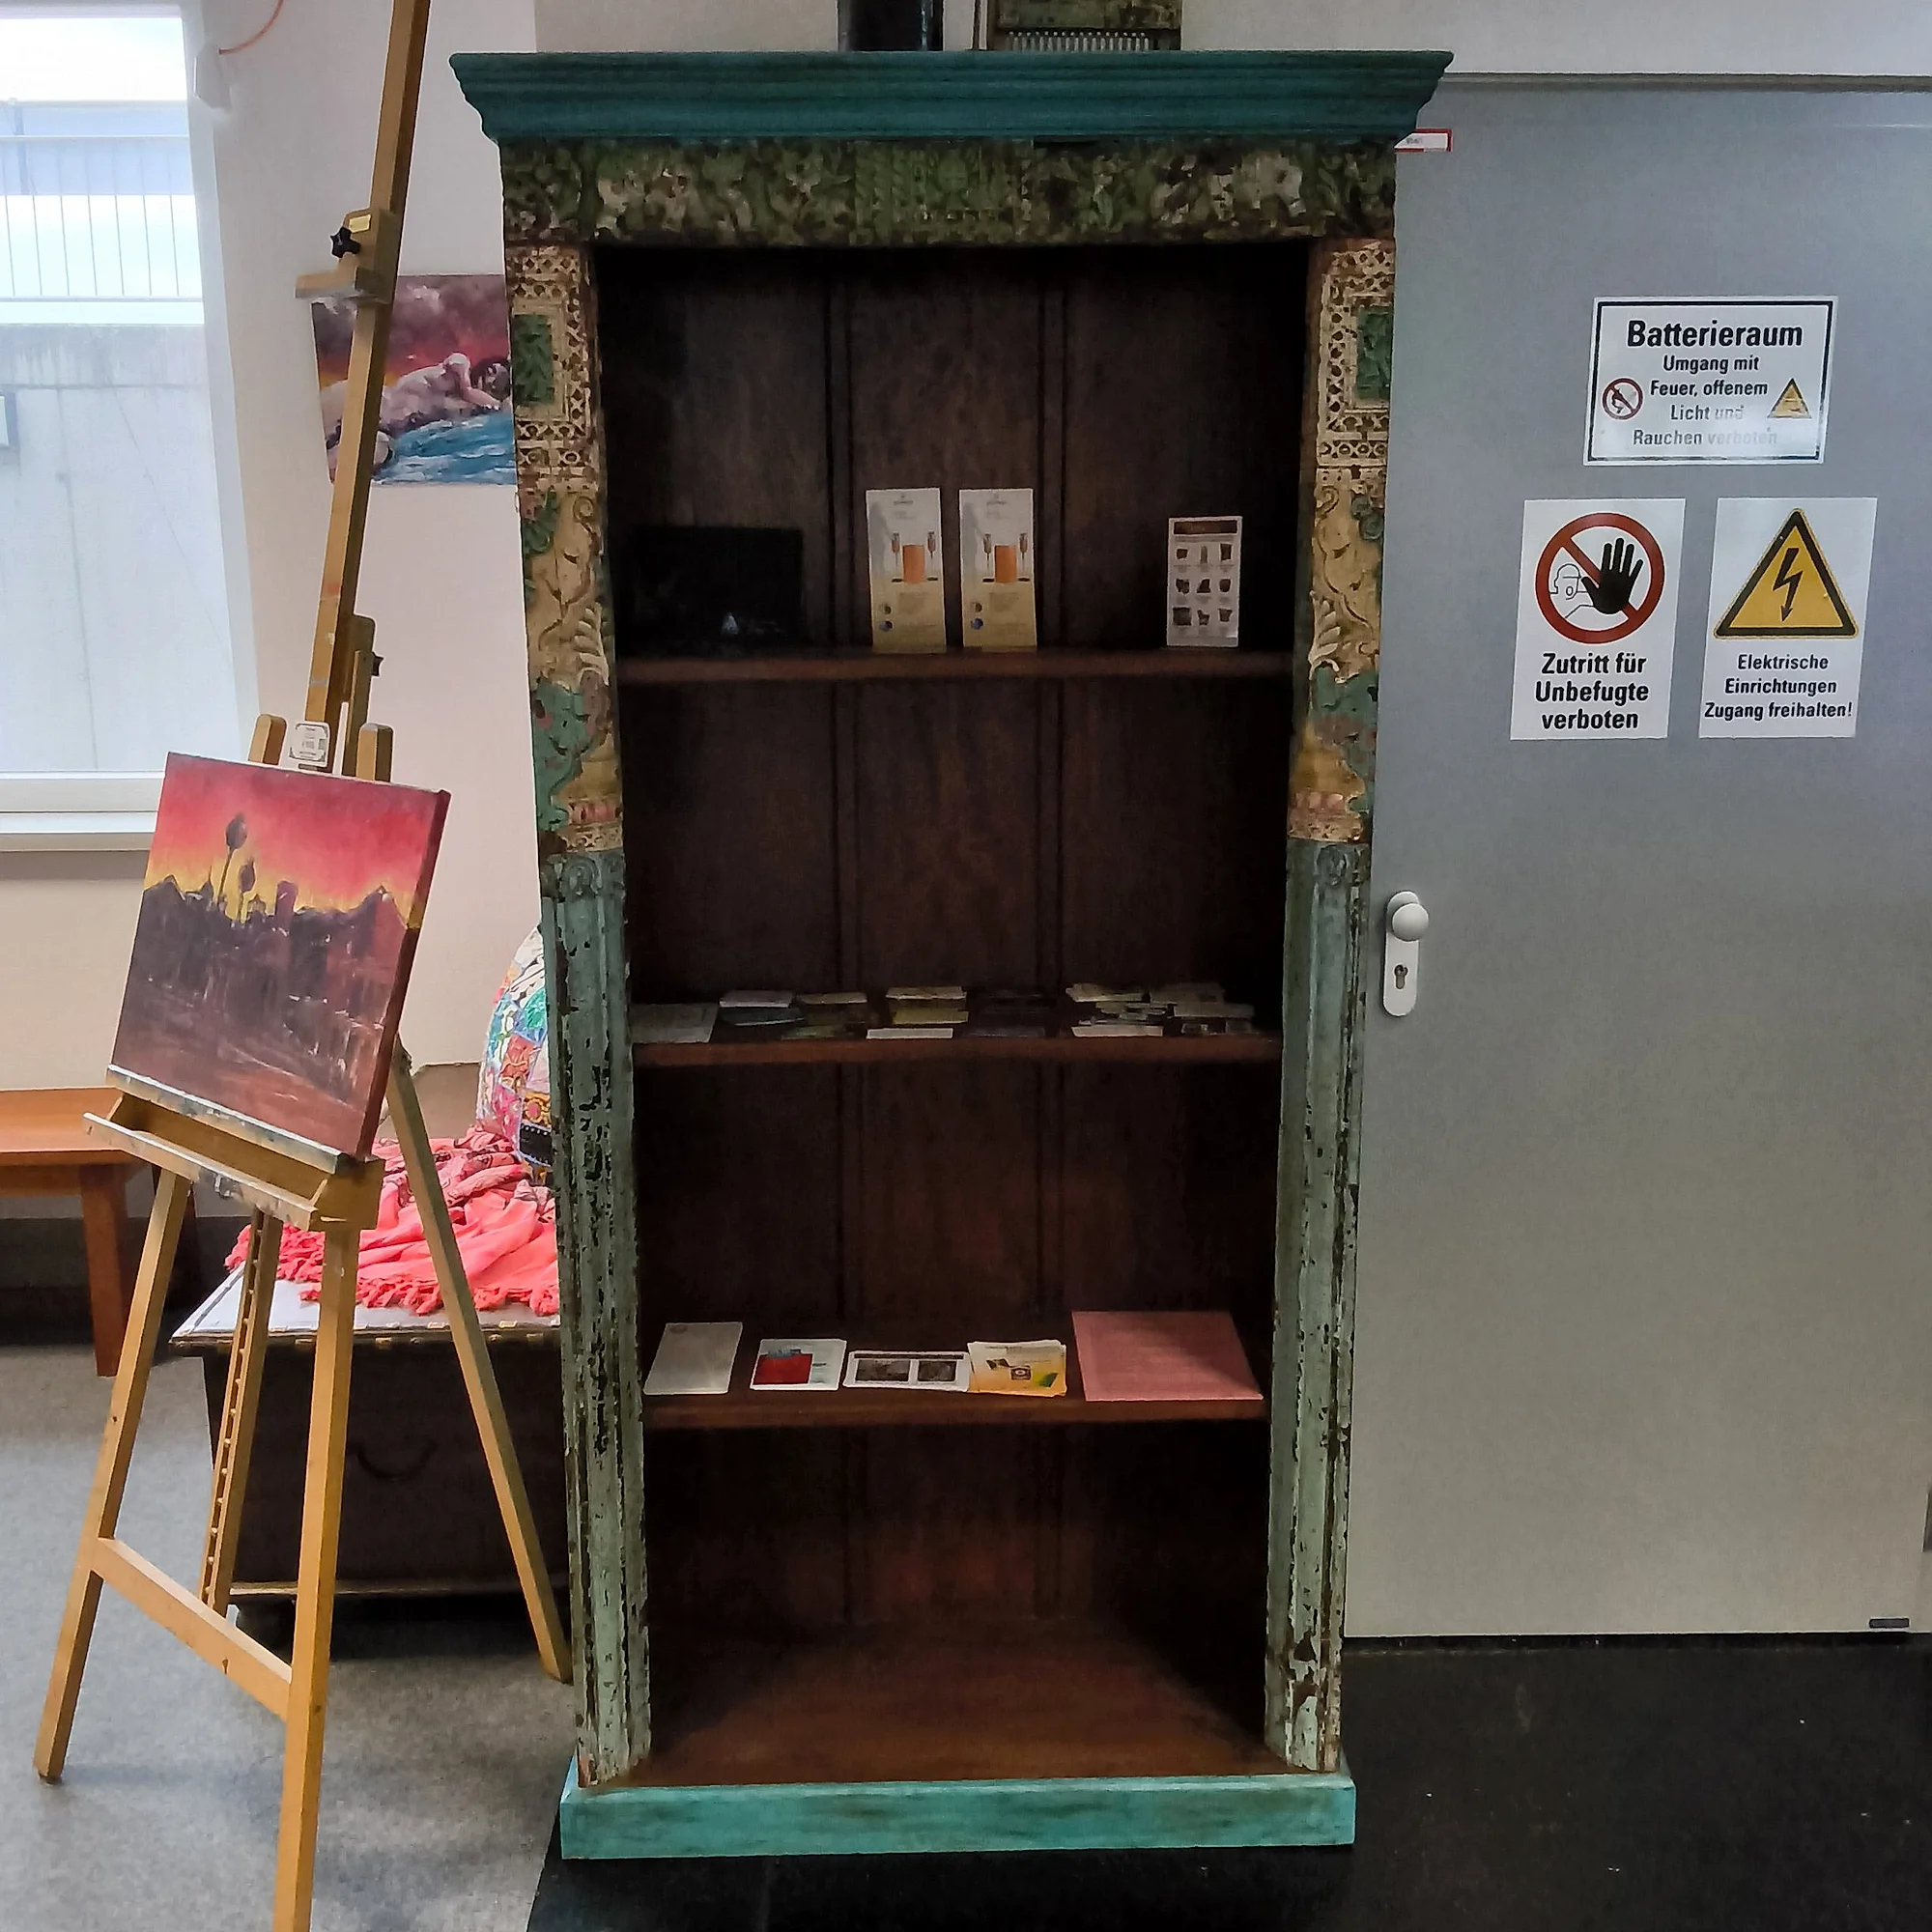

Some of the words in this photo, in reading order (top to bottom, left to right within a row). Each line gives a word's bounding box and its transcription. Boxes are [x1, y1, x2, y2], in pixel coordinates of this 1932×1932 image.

[1628, 320, 1803, 347] Batterieraum
[1662, 355, 1729, 374] Umgang
[1734, 355, 1759, 370] mit
[1650, 380, 1698, 397] Feuer,
[1703, 379, 1768, 396] offenem
[1670, 404, 1710, 420] Licht
[1633, 429, 1702, 445] Rauchen
[1541, 652, 1609, 674] Zutritt
[1615, 652, 1647, 673] für
[1738, 654, 1829, 669] Elektrische
[1535, 680, 1649, 706] Unbefugte
[1724, 677, 1836, 696] Einrichtungen
[1542, 708, 1639, 729] verboten
[1704, 702, 1764, 722] Zugang
[1769, 701, 1853, 718] freihalten!
